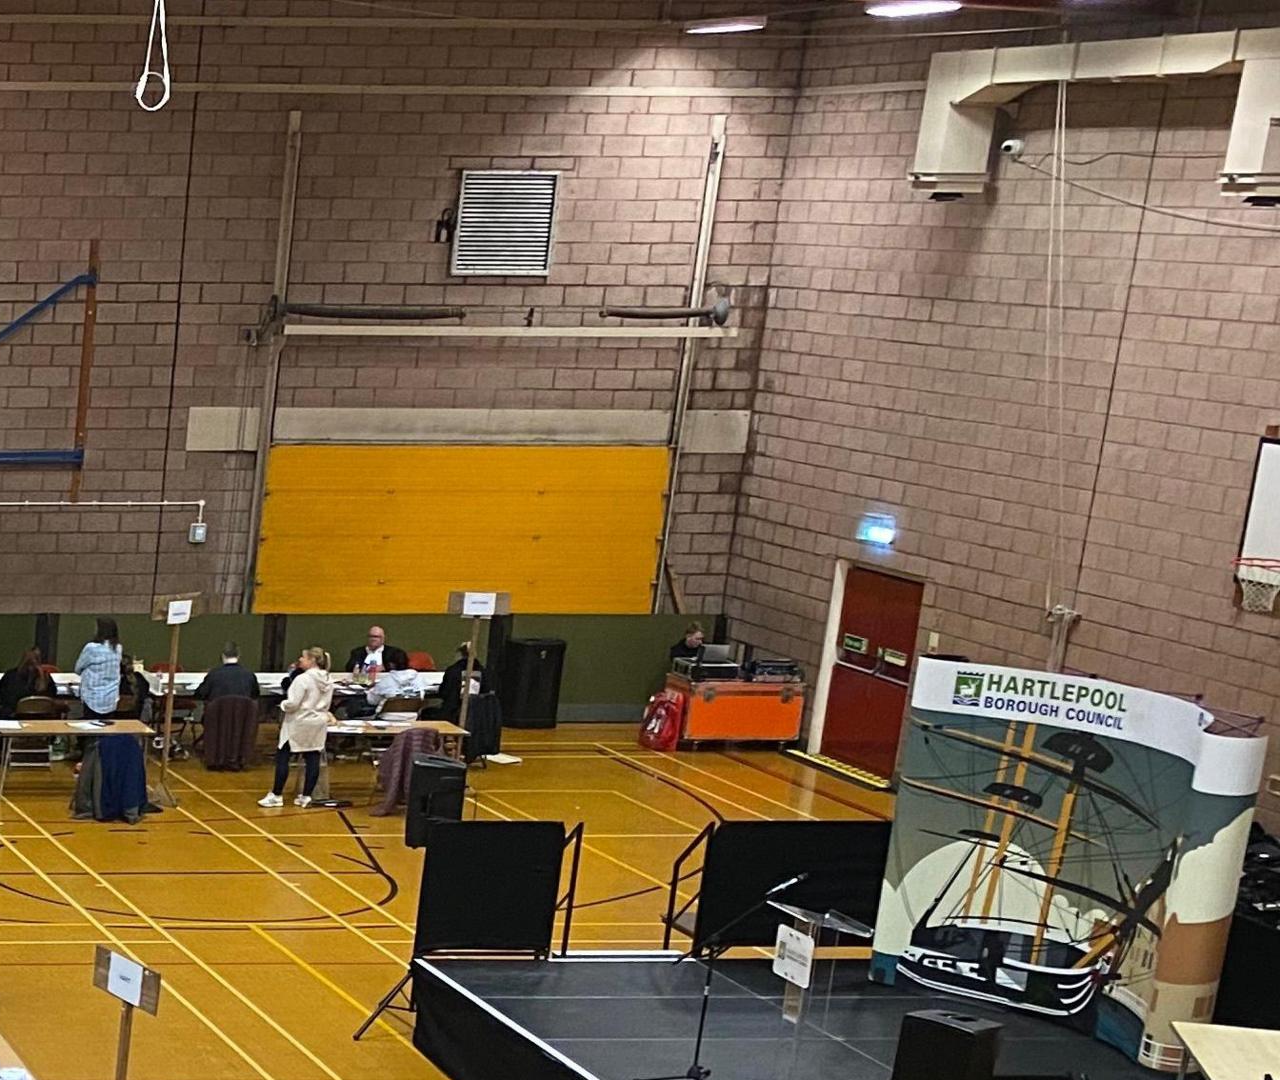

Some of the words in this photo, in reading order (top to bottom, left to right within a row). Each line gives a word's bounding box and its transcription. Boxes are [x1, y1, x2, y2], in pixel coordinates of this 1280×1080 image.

[986, 673, 1128, 712] HARTLEPOOL
[983, 696, 1059, 718] BOROUGH
[1065, 707, 1123, 731] COUNCIL
